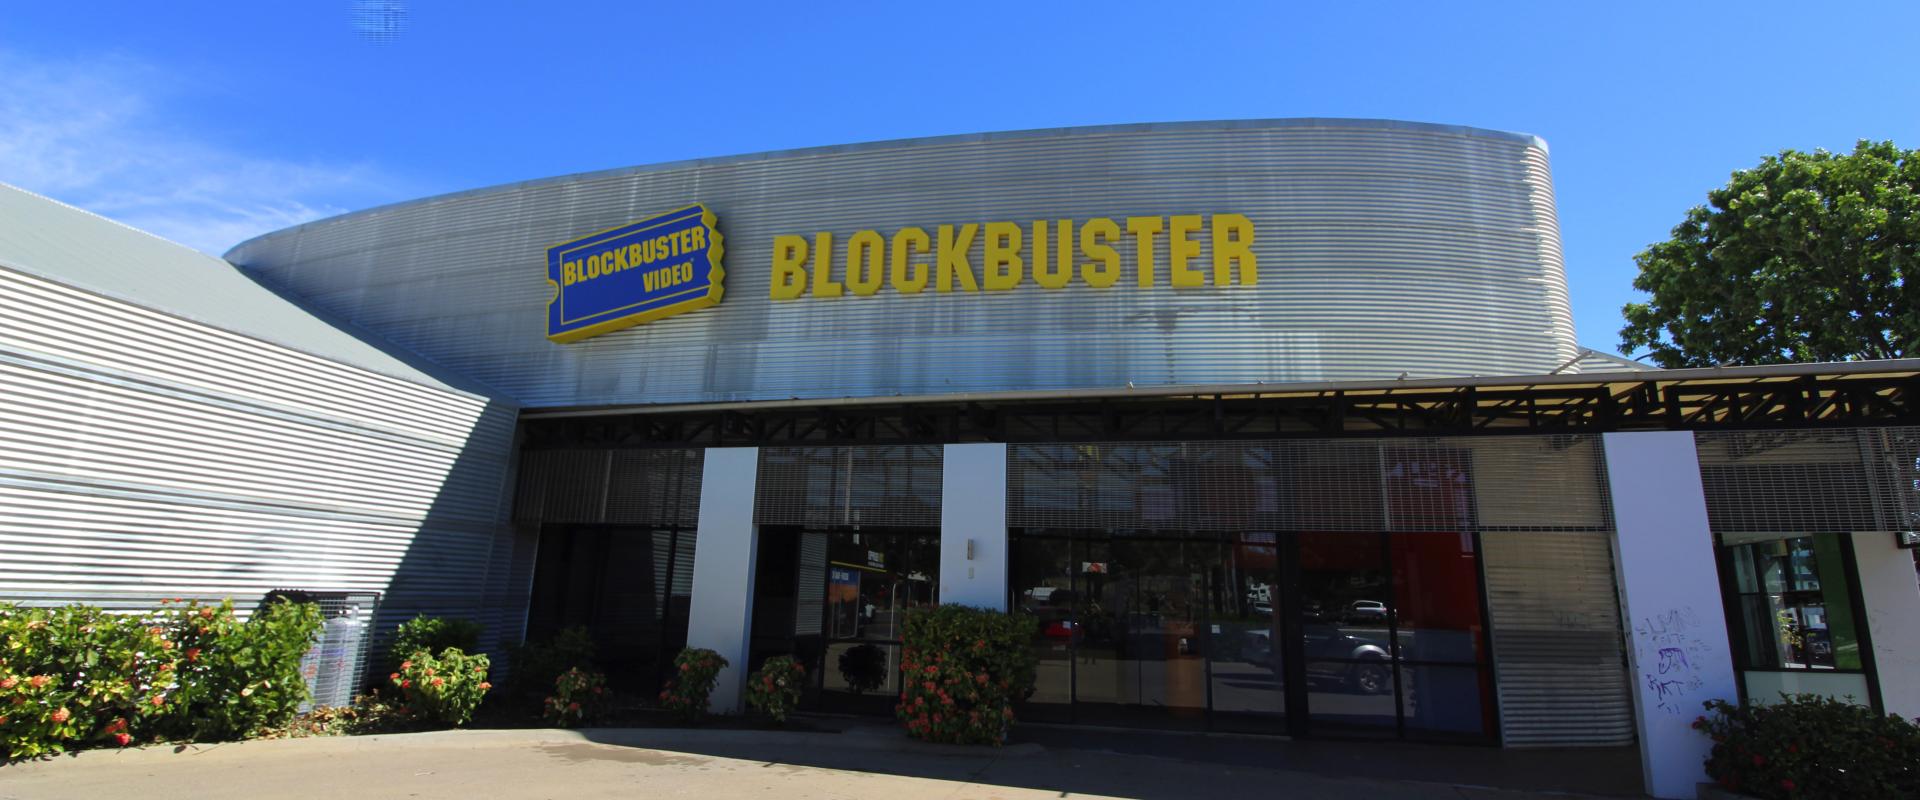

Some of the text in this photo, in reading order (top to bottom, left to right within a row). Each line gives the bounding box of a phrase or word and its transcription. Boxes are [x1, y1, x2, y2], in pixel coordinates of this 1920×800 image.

[563, 225, 706, 287] BLOCKBUSTER
[642, 262, 694, 293] VIDEO
[771, 214, 1258, 299] BLOCKBUSTER
